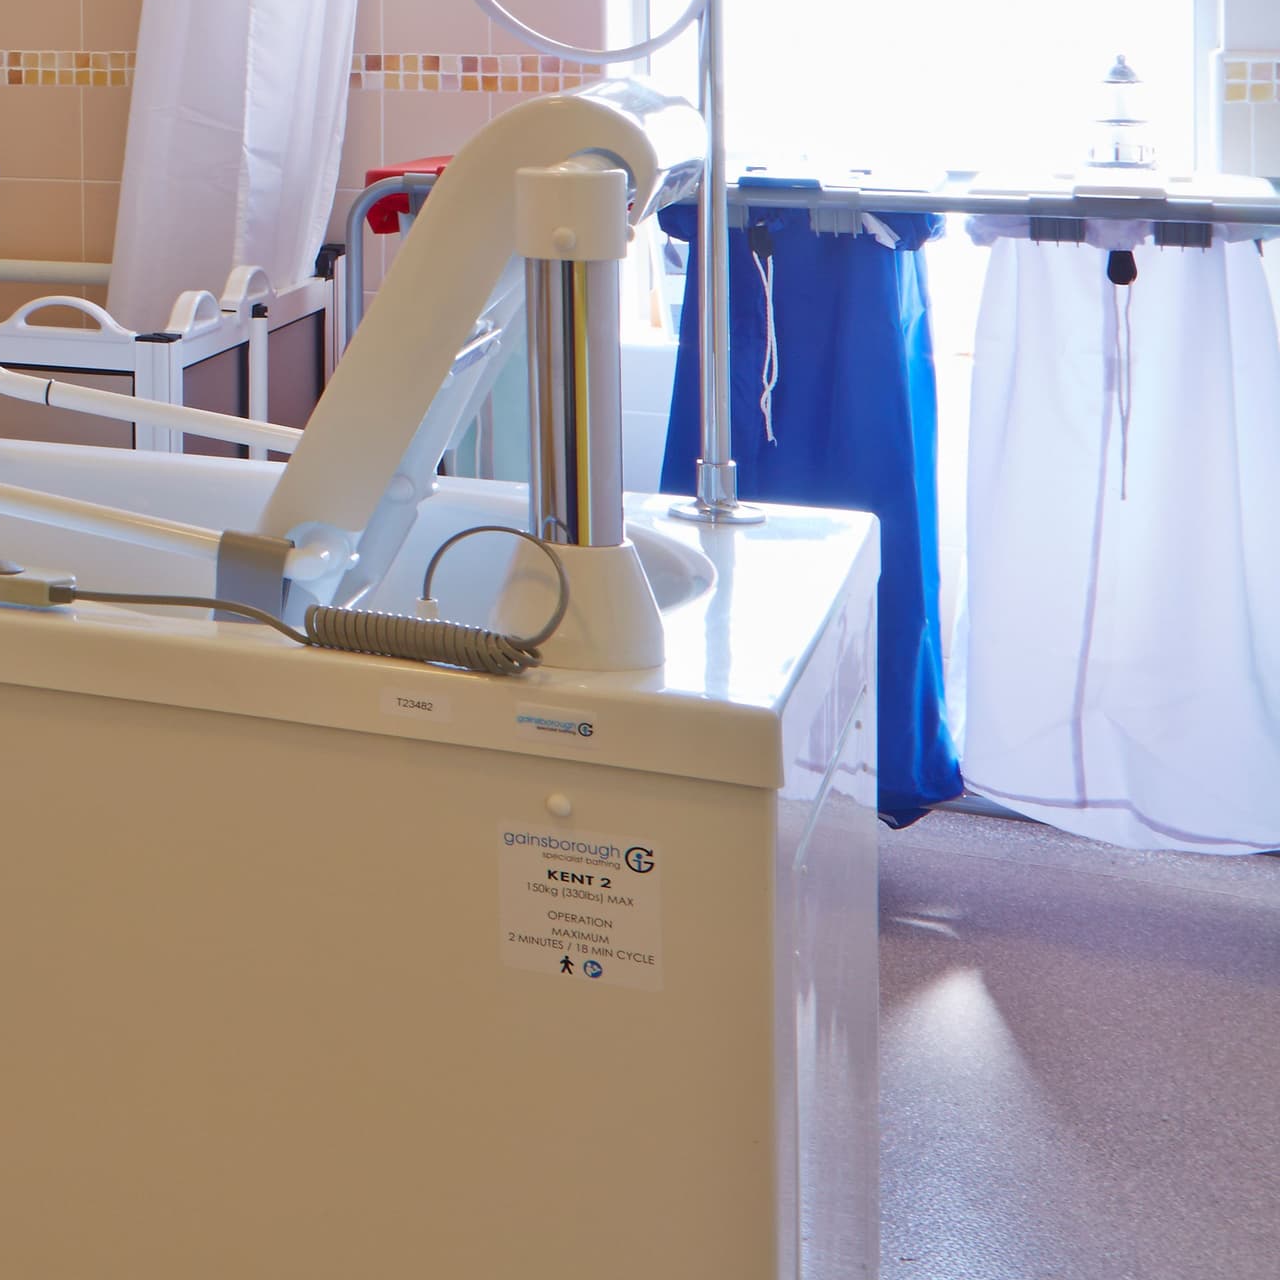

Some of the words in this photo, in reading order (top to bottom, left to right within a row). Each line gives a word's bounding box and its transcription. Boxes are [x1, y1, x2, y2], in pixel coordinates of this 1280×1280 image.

[503, 831, 621, 860] gainsborough
[585, 857, 621, 871] bathing
[547, 869, 594, 886] KENT
[600, 877, 612, 889] 2
[526, 882, 559, 898] 150kg
[561, 887, 604, 905] (330lbs)
[607, 894, 634, 907] MAX
[547, 910, 613, 929] OPERATION
[551, 927, 610, 945] MAXIMUM
[508, 932, 515, 942] 2
[518, 934, 564, 951] MINUTES
[591, 946, 614, 959] MIN
[616, 950, 656, 966] CYCLE
